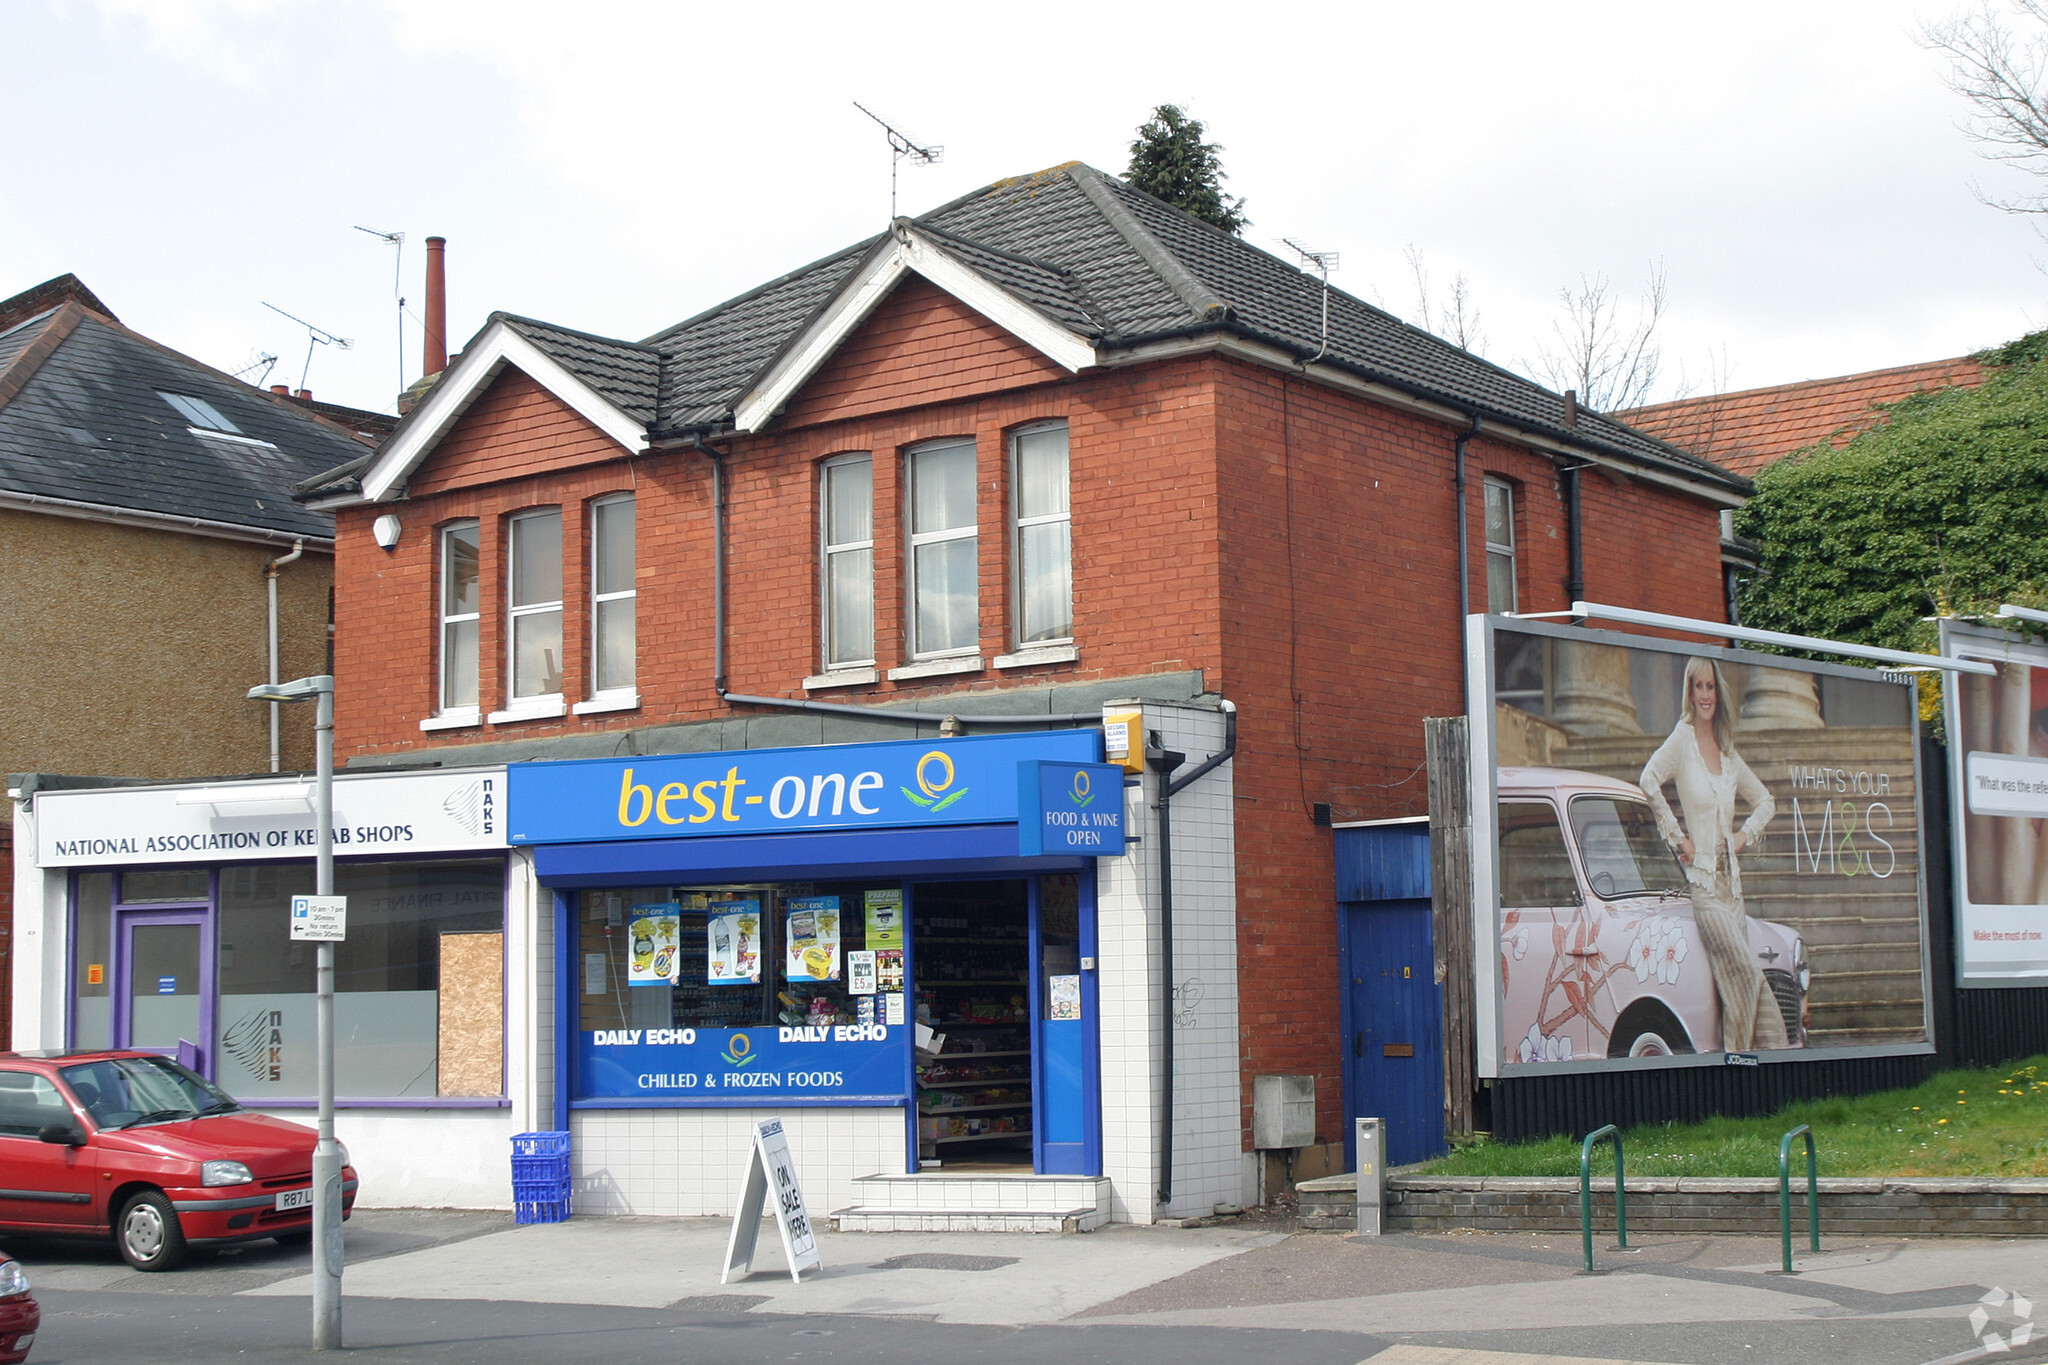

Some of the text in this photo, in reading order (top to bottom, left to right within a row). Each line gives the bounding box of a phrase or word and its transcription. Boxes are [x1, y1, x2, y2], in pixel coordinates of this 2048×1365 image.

[1790, 766, 1891, 796] WHAT'S YOUR
[2001, 780, 2016, 792] was
[2017, 779, 2031, 793] the
[617, 766, 884, 827] best-one
[1046, 811, 1118, 827] FOOD & WINE
[55, 825, 414, 856] NATIONAL ASSOCIATION OF KEAB SHOPS
[1066, 830, 1101, 845] OPEN
[1793, 797, 1896, 879] M&S
[296, 901, 307, 917] P
[1974, 930, 1991, 940] Make
[1992, 930, 2004, 940] the
[2004, 931, 2021, 940] most
[2022, 929, 2028, 940] of
[593, 1028, 696, 1046] DAILY ECHO
[779, 1025, 888, 1043] DAILY ECHO
[637, 1071, 844, 1088] CHILLED & FROZEN FOODS
[777, 1164, 790, 1187] ON
[283, 1191, 303, 1207] R87
[781, 1188, 800, 1214] SALE
[787, 1215, 809, 1240] HERE
